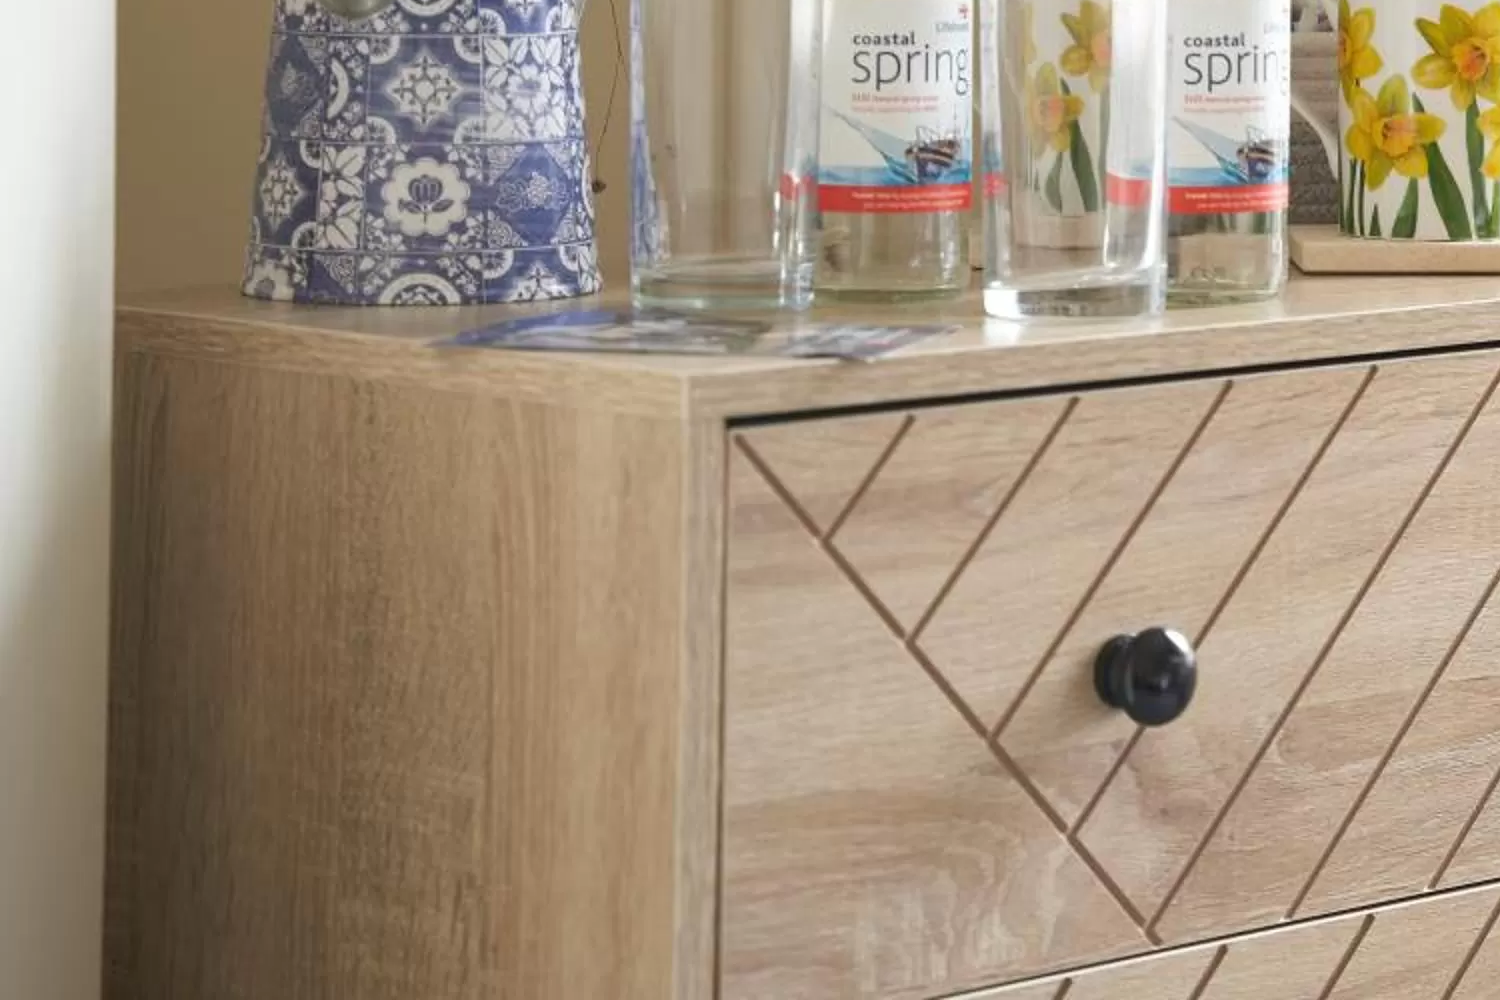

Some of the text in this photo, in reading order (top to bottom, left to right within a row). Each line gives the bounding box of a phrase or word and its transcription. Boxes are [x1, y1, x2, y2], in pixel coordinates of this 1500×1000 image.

[853, 30, 916, 45] coastal
[1184, 32, 1245, 47] coastal
[851, 43, 968, 96] spring
